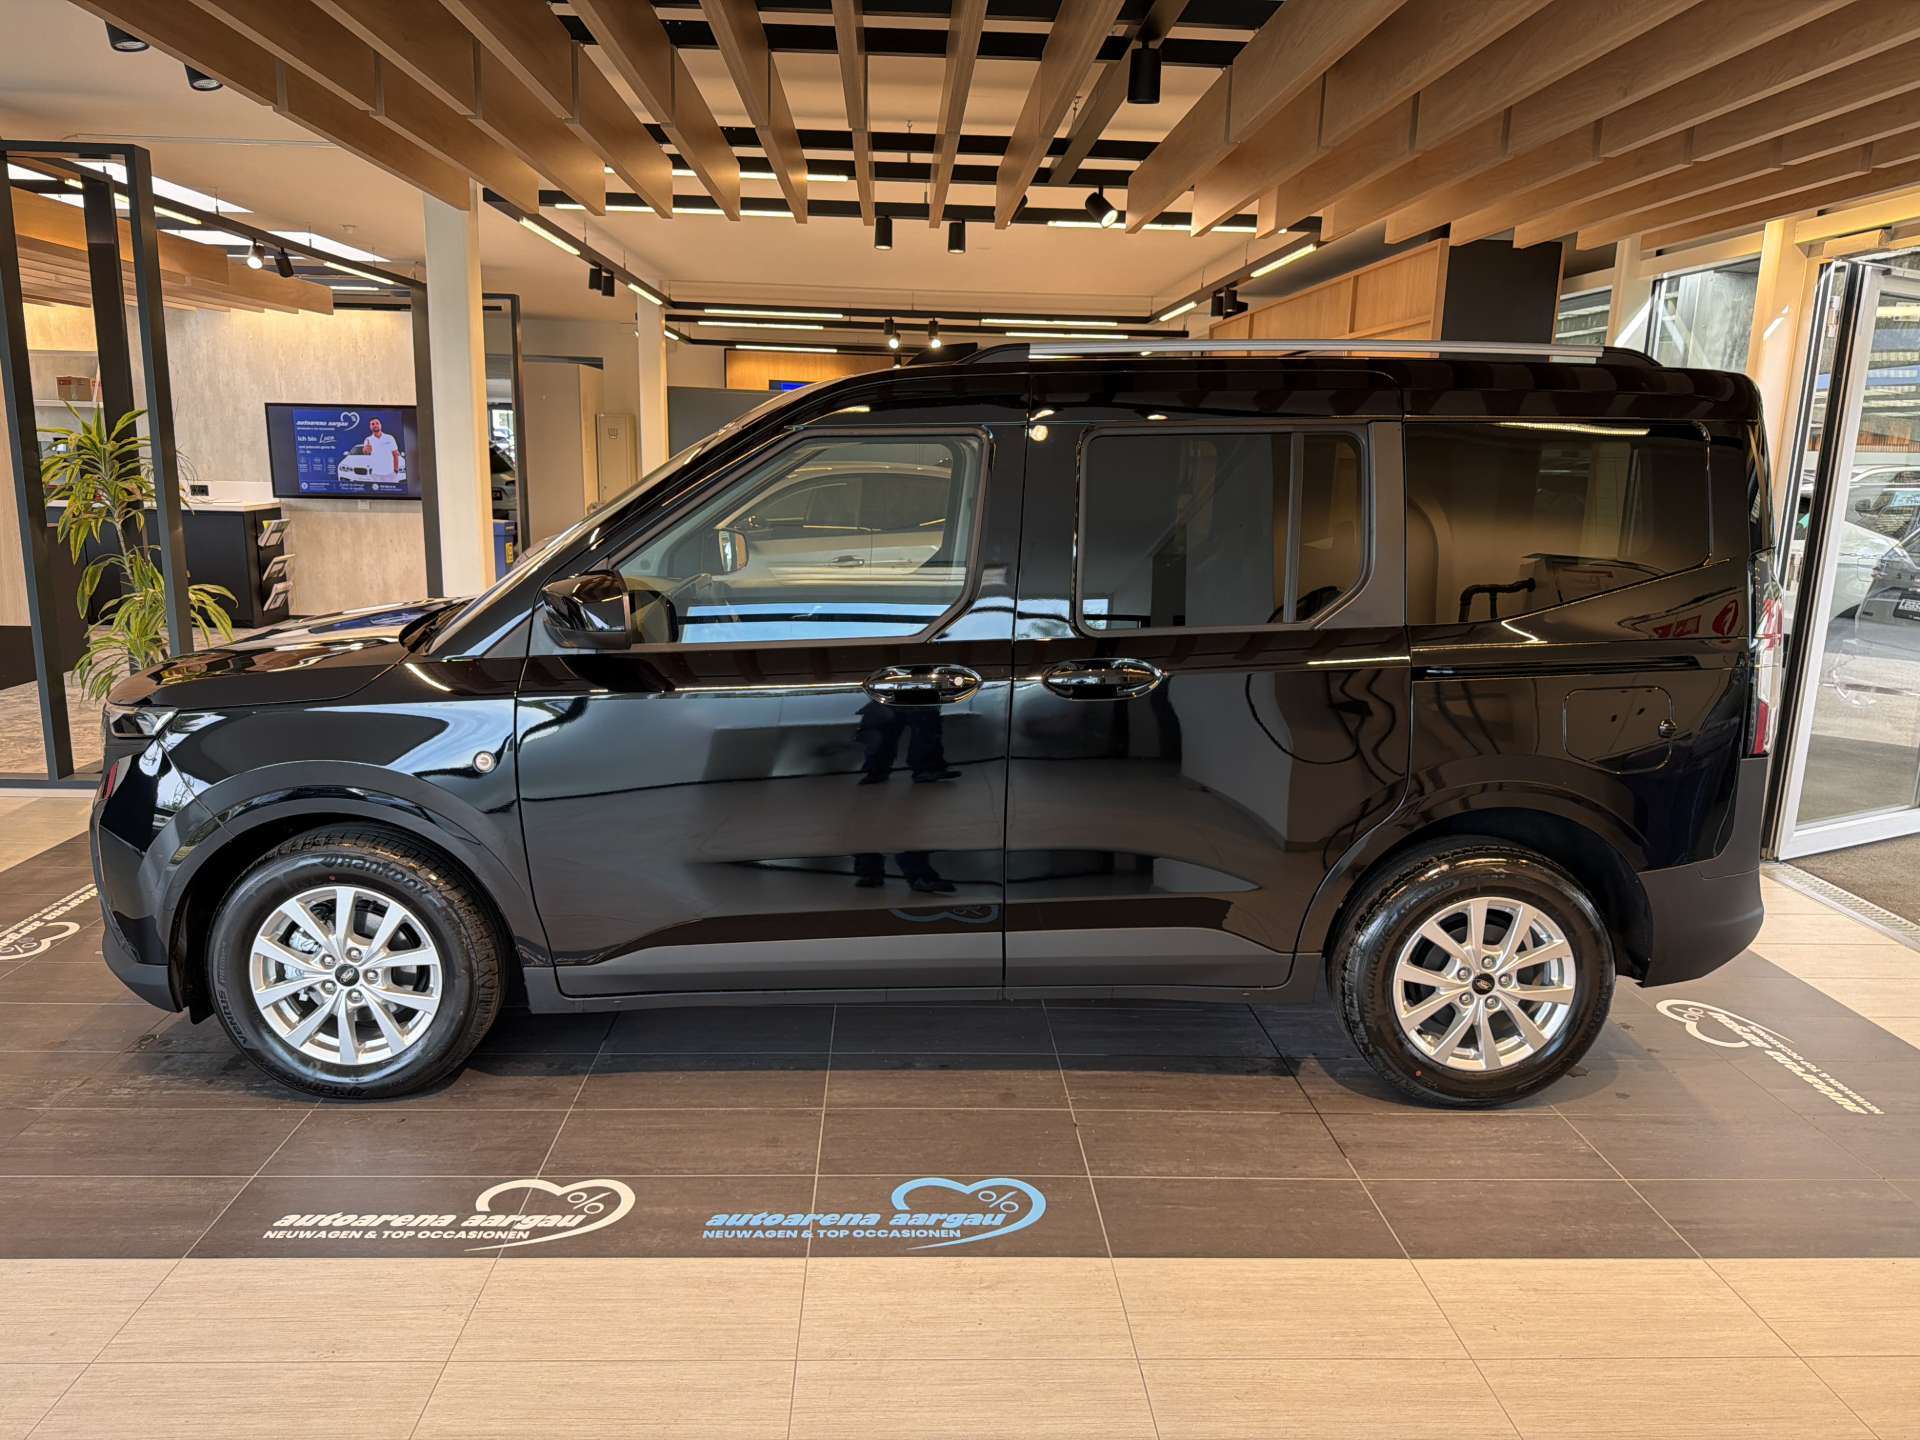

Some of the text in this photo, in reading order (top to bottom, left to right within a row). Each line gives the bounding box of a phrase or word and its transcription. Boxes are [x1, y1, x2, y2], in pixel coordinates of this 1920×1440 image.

[272, 1211, 587, 1230] autoarena aargau
[705, 1211, 1006, 1228] autoarena aargau
[262, 1230, 531, 1240] NEUWAGEN & TOP OCCASIONEN
[702, 1229, 962, 1239] NEUWAGEN & TOP OCCASIONEN
